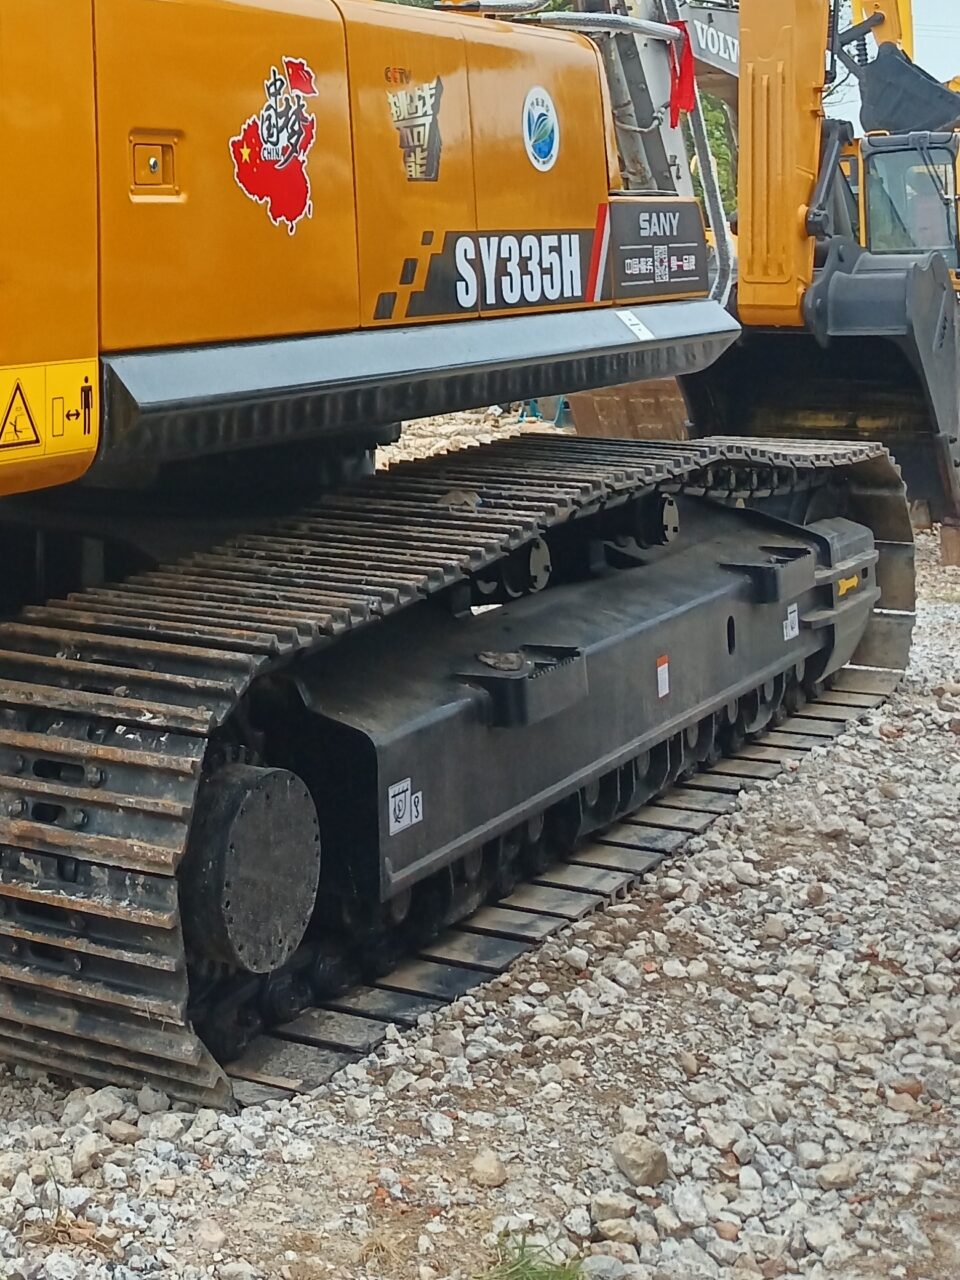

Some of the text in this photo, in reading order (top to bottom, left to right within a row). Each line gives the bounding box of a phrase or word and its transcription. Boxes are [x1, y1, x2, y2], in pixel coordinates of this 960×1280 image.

[693, 19, 739, 63] VOLV
[262, 146, 284, 160] CHIN
[640, 212, 679, 236] SANY
[455, 234, 582, 308] SY335H
